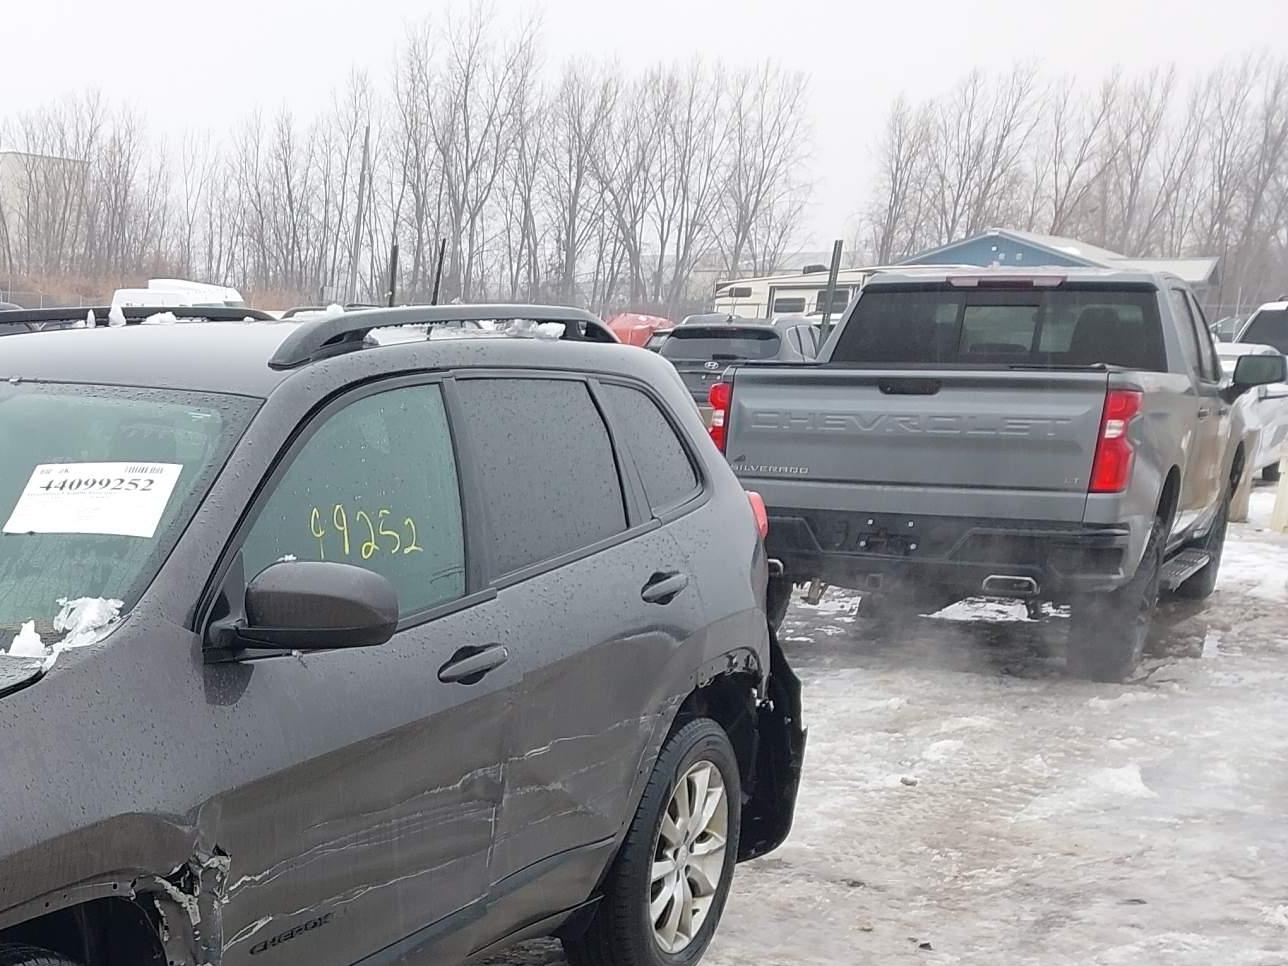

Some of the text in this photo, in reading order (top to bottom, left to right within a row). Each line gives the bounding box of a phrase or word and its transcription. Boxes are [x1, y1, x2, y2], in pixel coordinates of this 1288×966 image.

[750, 410, 1073, 438] CHEVROLET
[730, 464, 809, 474] SILVERADO
[39, 478, 155, 492] 44099252
[250, 908, 344, 955] CHEROK
